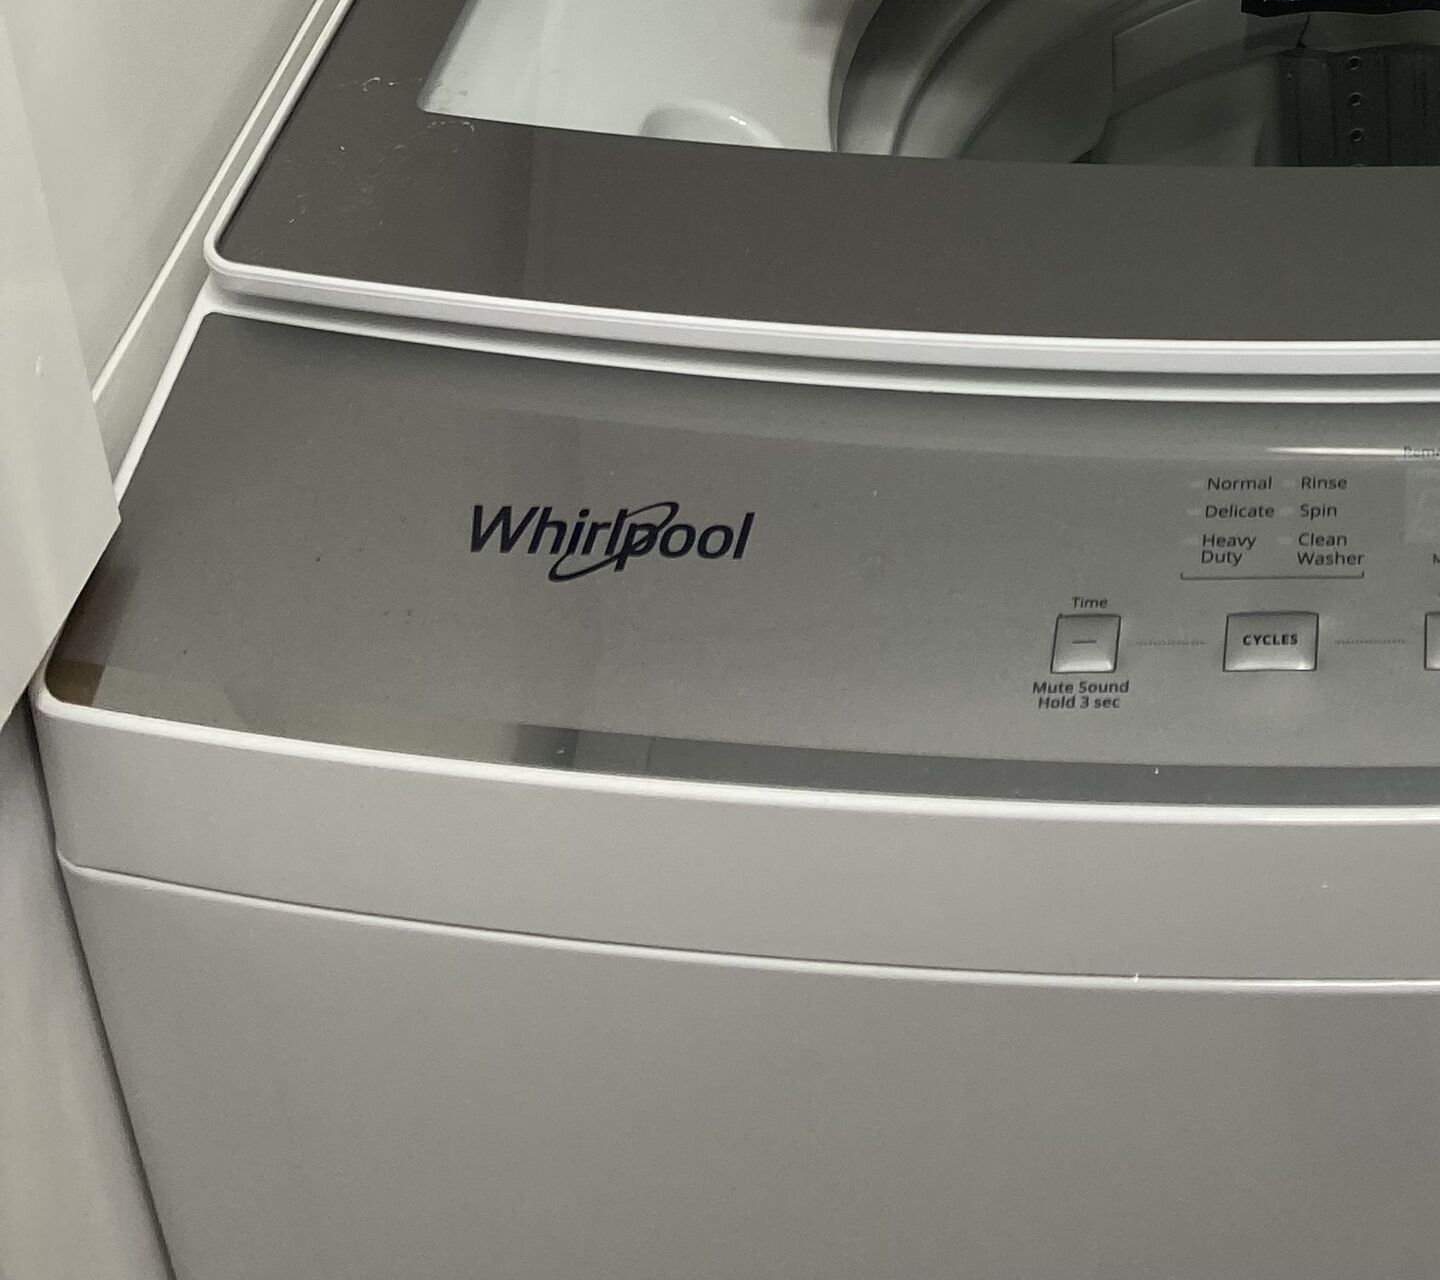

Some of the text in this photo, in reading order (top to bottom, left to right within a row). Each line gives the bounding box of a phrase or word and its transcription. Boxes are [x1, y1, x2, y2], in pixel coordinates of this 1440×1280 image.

[1207, 475, 1272, 491] Normal
[1301, 476, 1348, 491] Rinse
[1205, 504, 1275, 519] Delicate
[1300, 503, 1338, 520] Spin
[470, 502, 755, 582] Whirlpool
[1201, 533, 1257, 551] Heavy
[1298, 532, 1348, 547] Clean
[1201, 550, 1243, 567] Duty
[1296, 550, 1364, 566] Washer
[1071, 595, 1108, 609] Time
[1242, 633, 1298, 646] CYCLES
[1032, 680, 1130, 694] Mute Sound
[1038, 695, 1120, 709] Hold 3 sec
